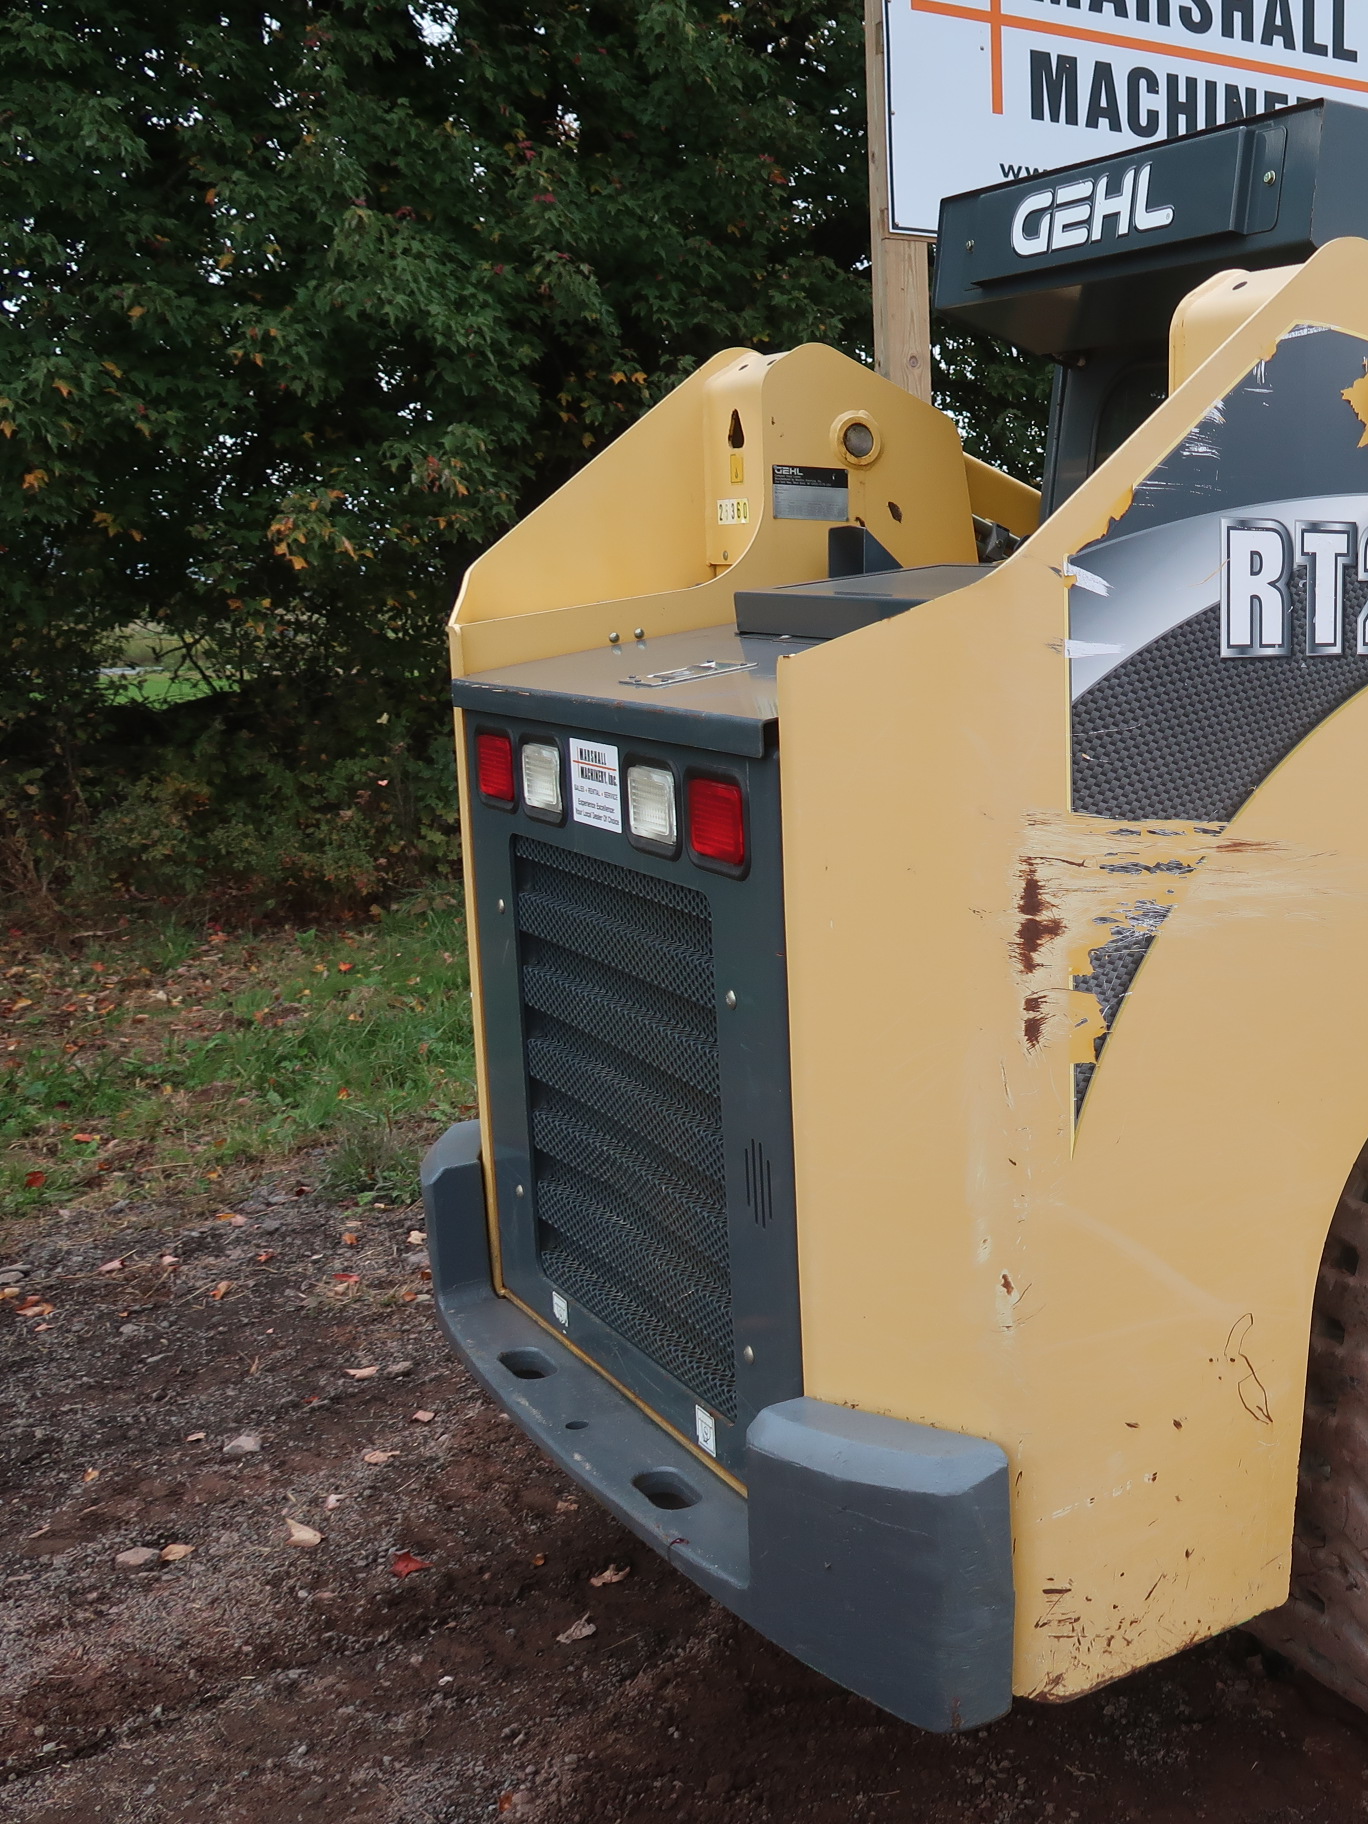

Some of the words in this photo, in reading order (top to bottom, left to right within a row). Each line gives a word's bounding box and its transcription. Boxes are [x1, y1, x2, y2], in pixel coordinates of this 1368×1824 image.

[1030, 0, 1358, 62] SHALL
[1030, 50, 1314, 138] MACHIN
[1011, 161, 1175, 258] GEHL
[774, 466, 804, 476] GEHL
[579, 748, 606, 765] MARSHALL
